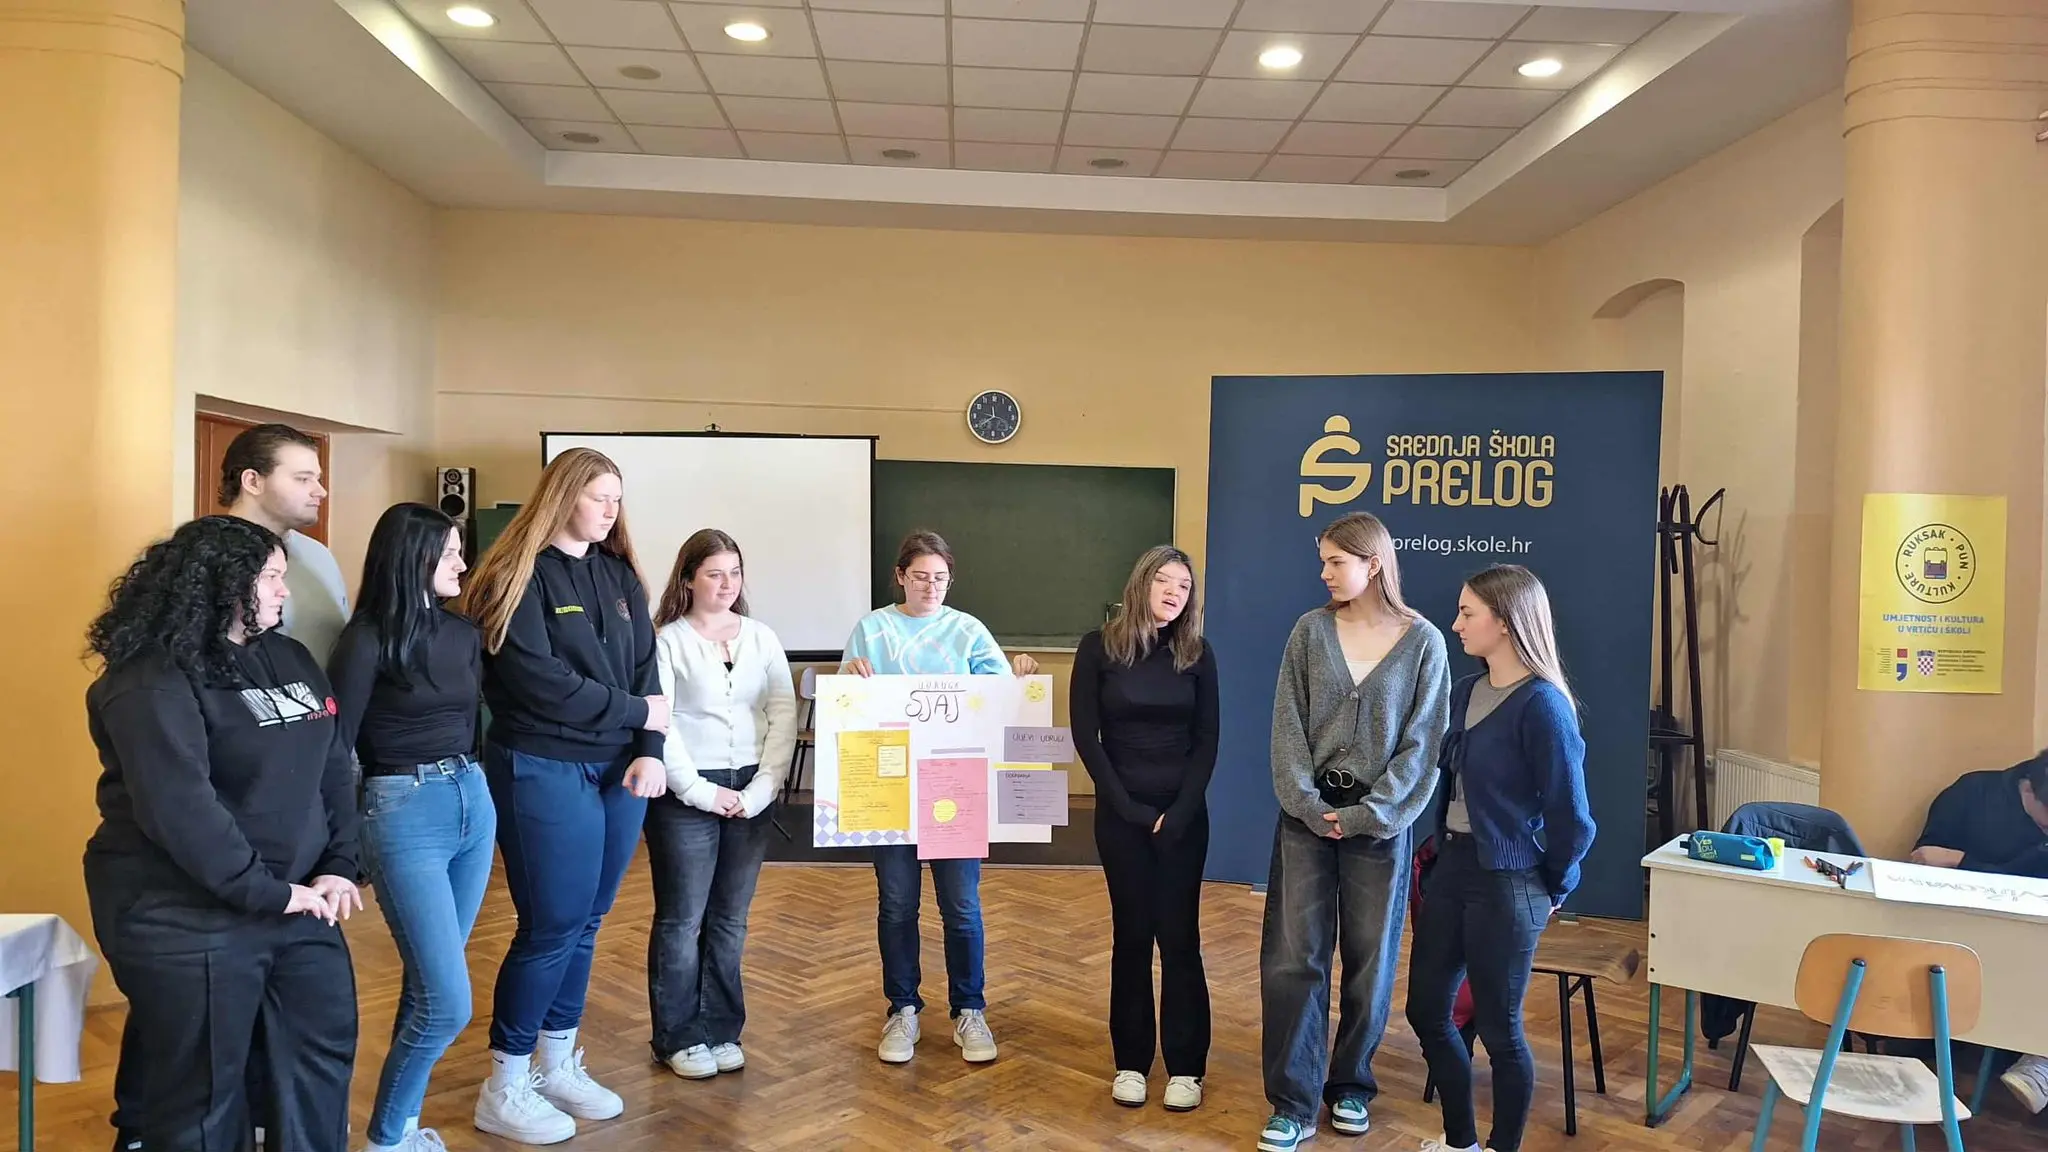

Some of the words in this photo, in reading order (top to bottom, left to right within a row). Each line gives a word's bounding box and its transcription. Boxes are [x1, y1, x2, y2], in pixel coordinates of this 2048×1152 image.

[1386, 434, 1481, 457] SREDNJA
[1488, 429, 1555, 458] ŠKOLA
[1382, 458, 1554, 508] PRELOG
[1903, 529, 1947, 557] RUKSAK
[1955, 543, 1969, 570] PUN
[1904, 571, 1956, 596] KULTURE
[1883, 614, 1937, 623] UMJETNOST
[1945, 615, 1985, 624] KULTURA
[1898, 625, 1904, 633] U
[905, 689, 967, 723] SJAJ
